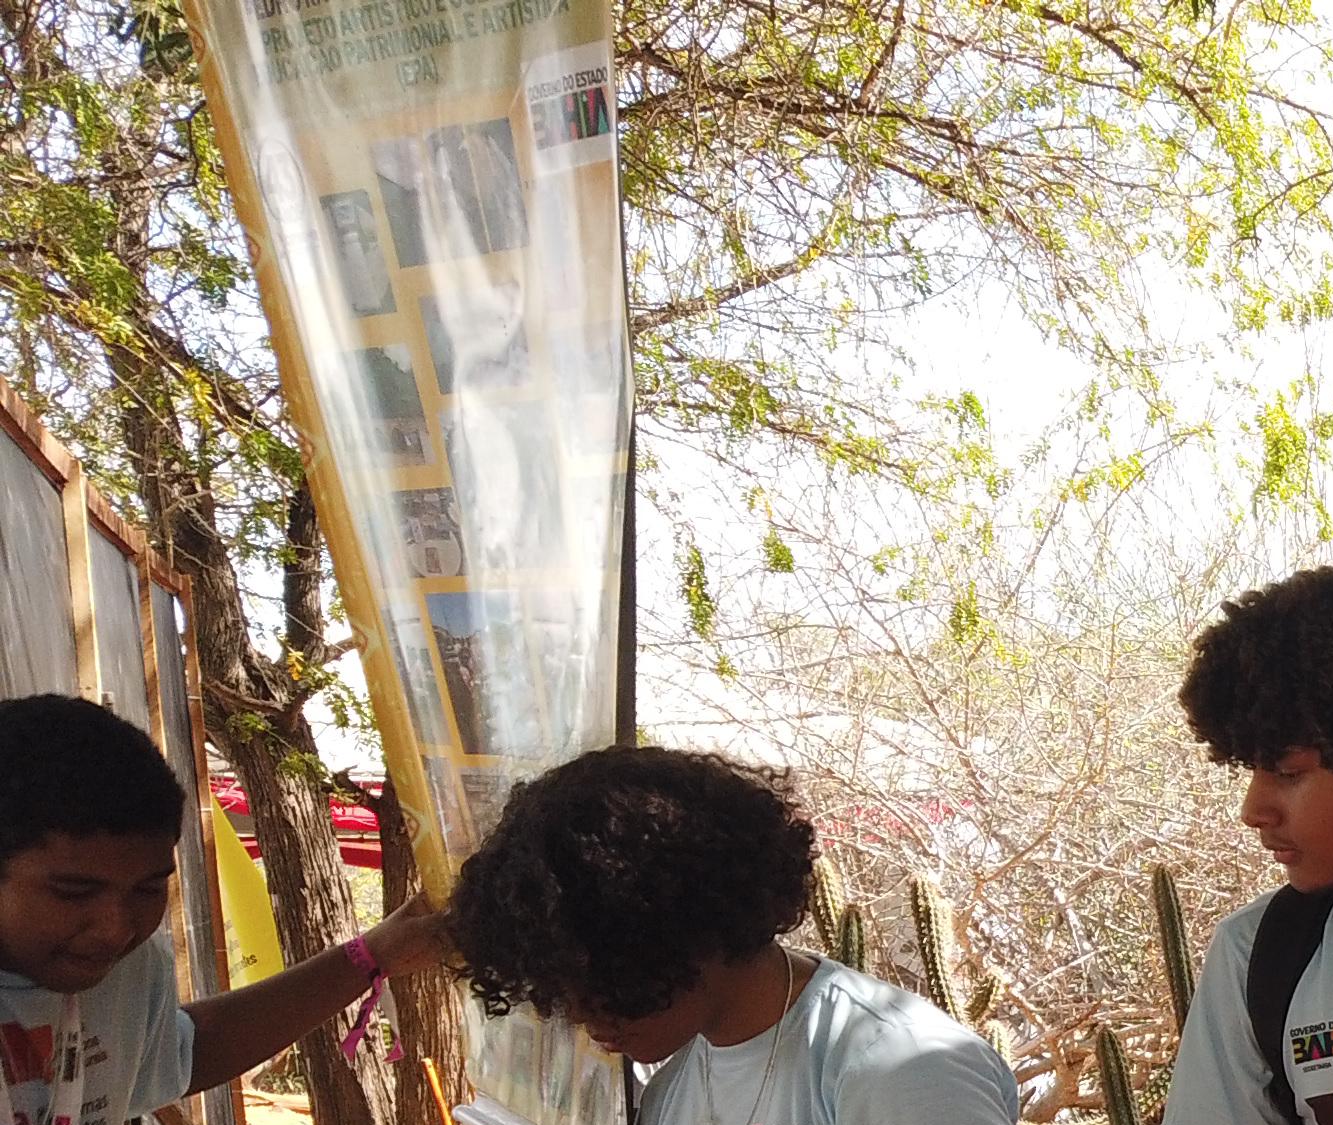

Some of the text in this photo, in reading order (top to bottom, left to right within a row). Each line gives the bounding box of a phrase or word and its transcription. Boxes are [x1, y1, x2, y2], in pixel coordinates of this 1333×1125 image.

[262, 15, 338, 55] PROETO
[575, 67, 608, 89] ESTADO
[1290, 1022, 1326, 1037] GOVERNO
